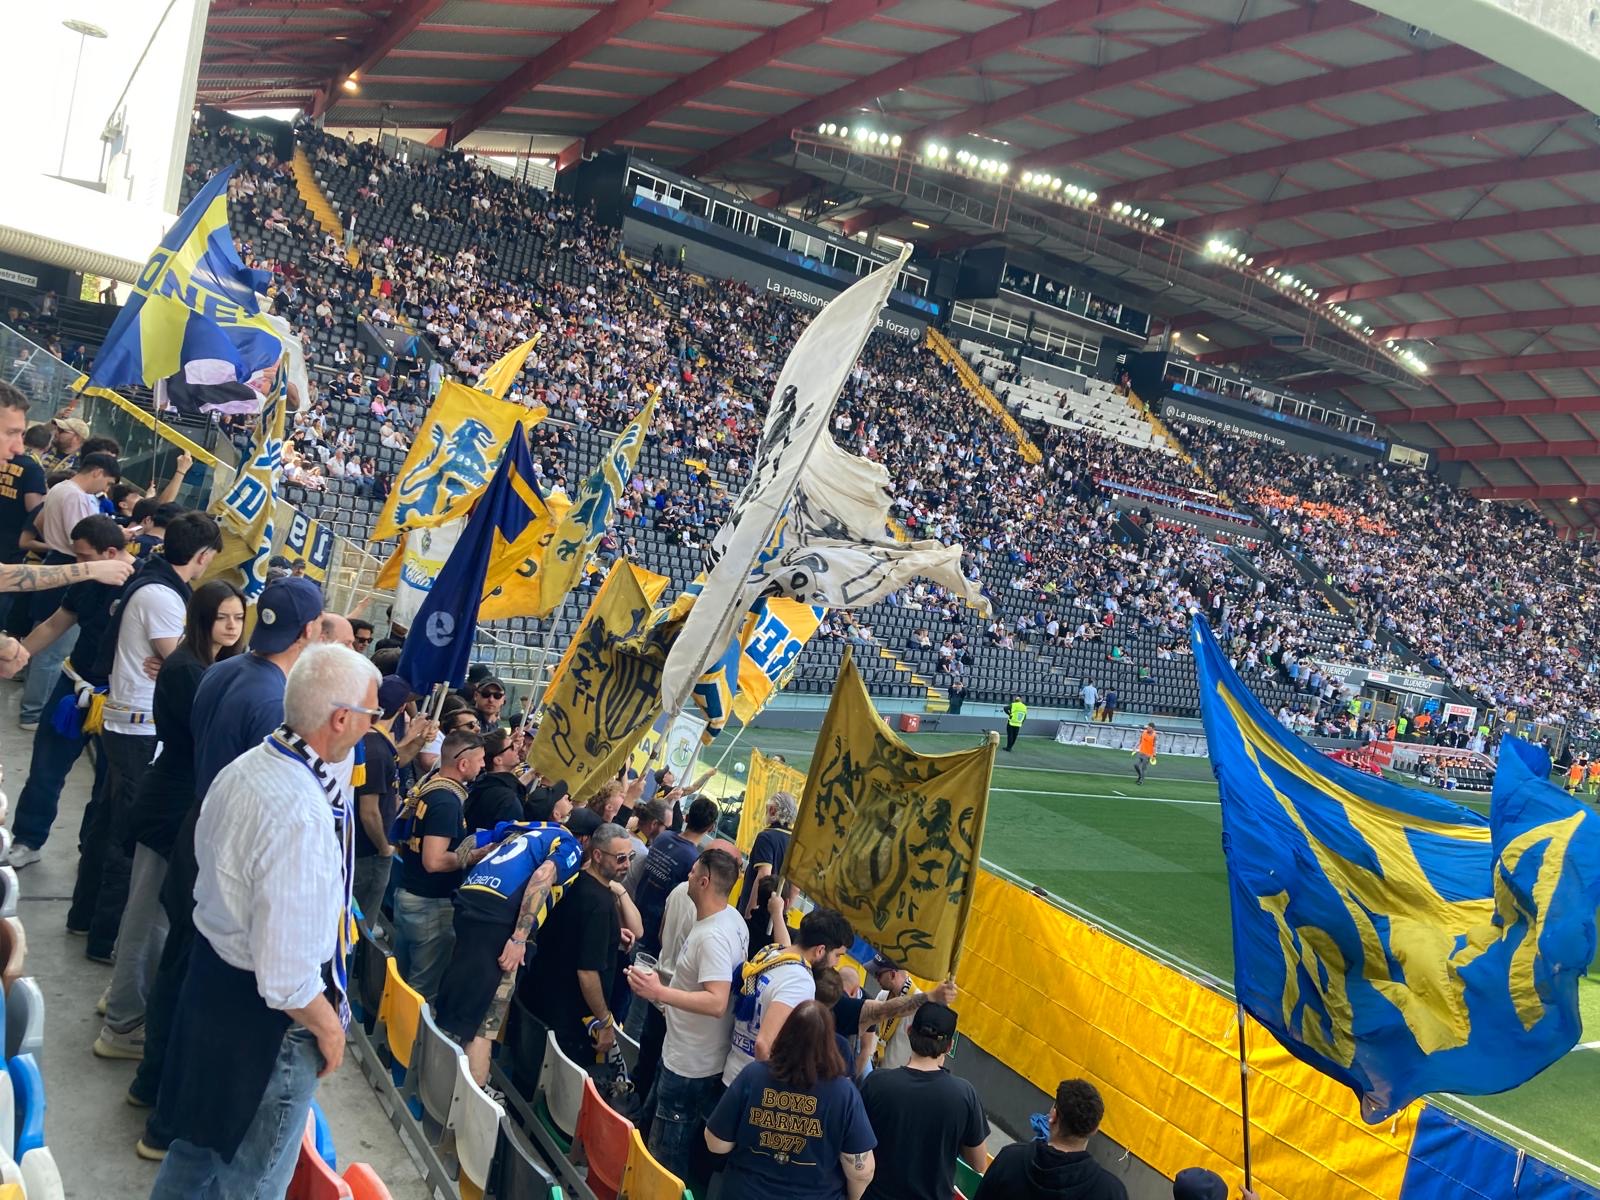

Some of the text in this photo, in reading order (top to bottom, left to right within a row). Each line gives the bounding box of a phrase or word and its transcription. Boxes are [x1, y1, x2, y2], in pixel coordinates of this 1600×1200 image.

[766, 278, 829, 308] La passione
[886, 319, 909, 336] forza
[1176, 408, 1185, 418] La
[1187, 413, 1215, 426] passion
[1232, 425, 1239, 433] la
[762, 1088, 817, 1115] BOYS
[750, 1107, 823, 1137] PARMA
[760, 1131, 806, 1154] 1977
